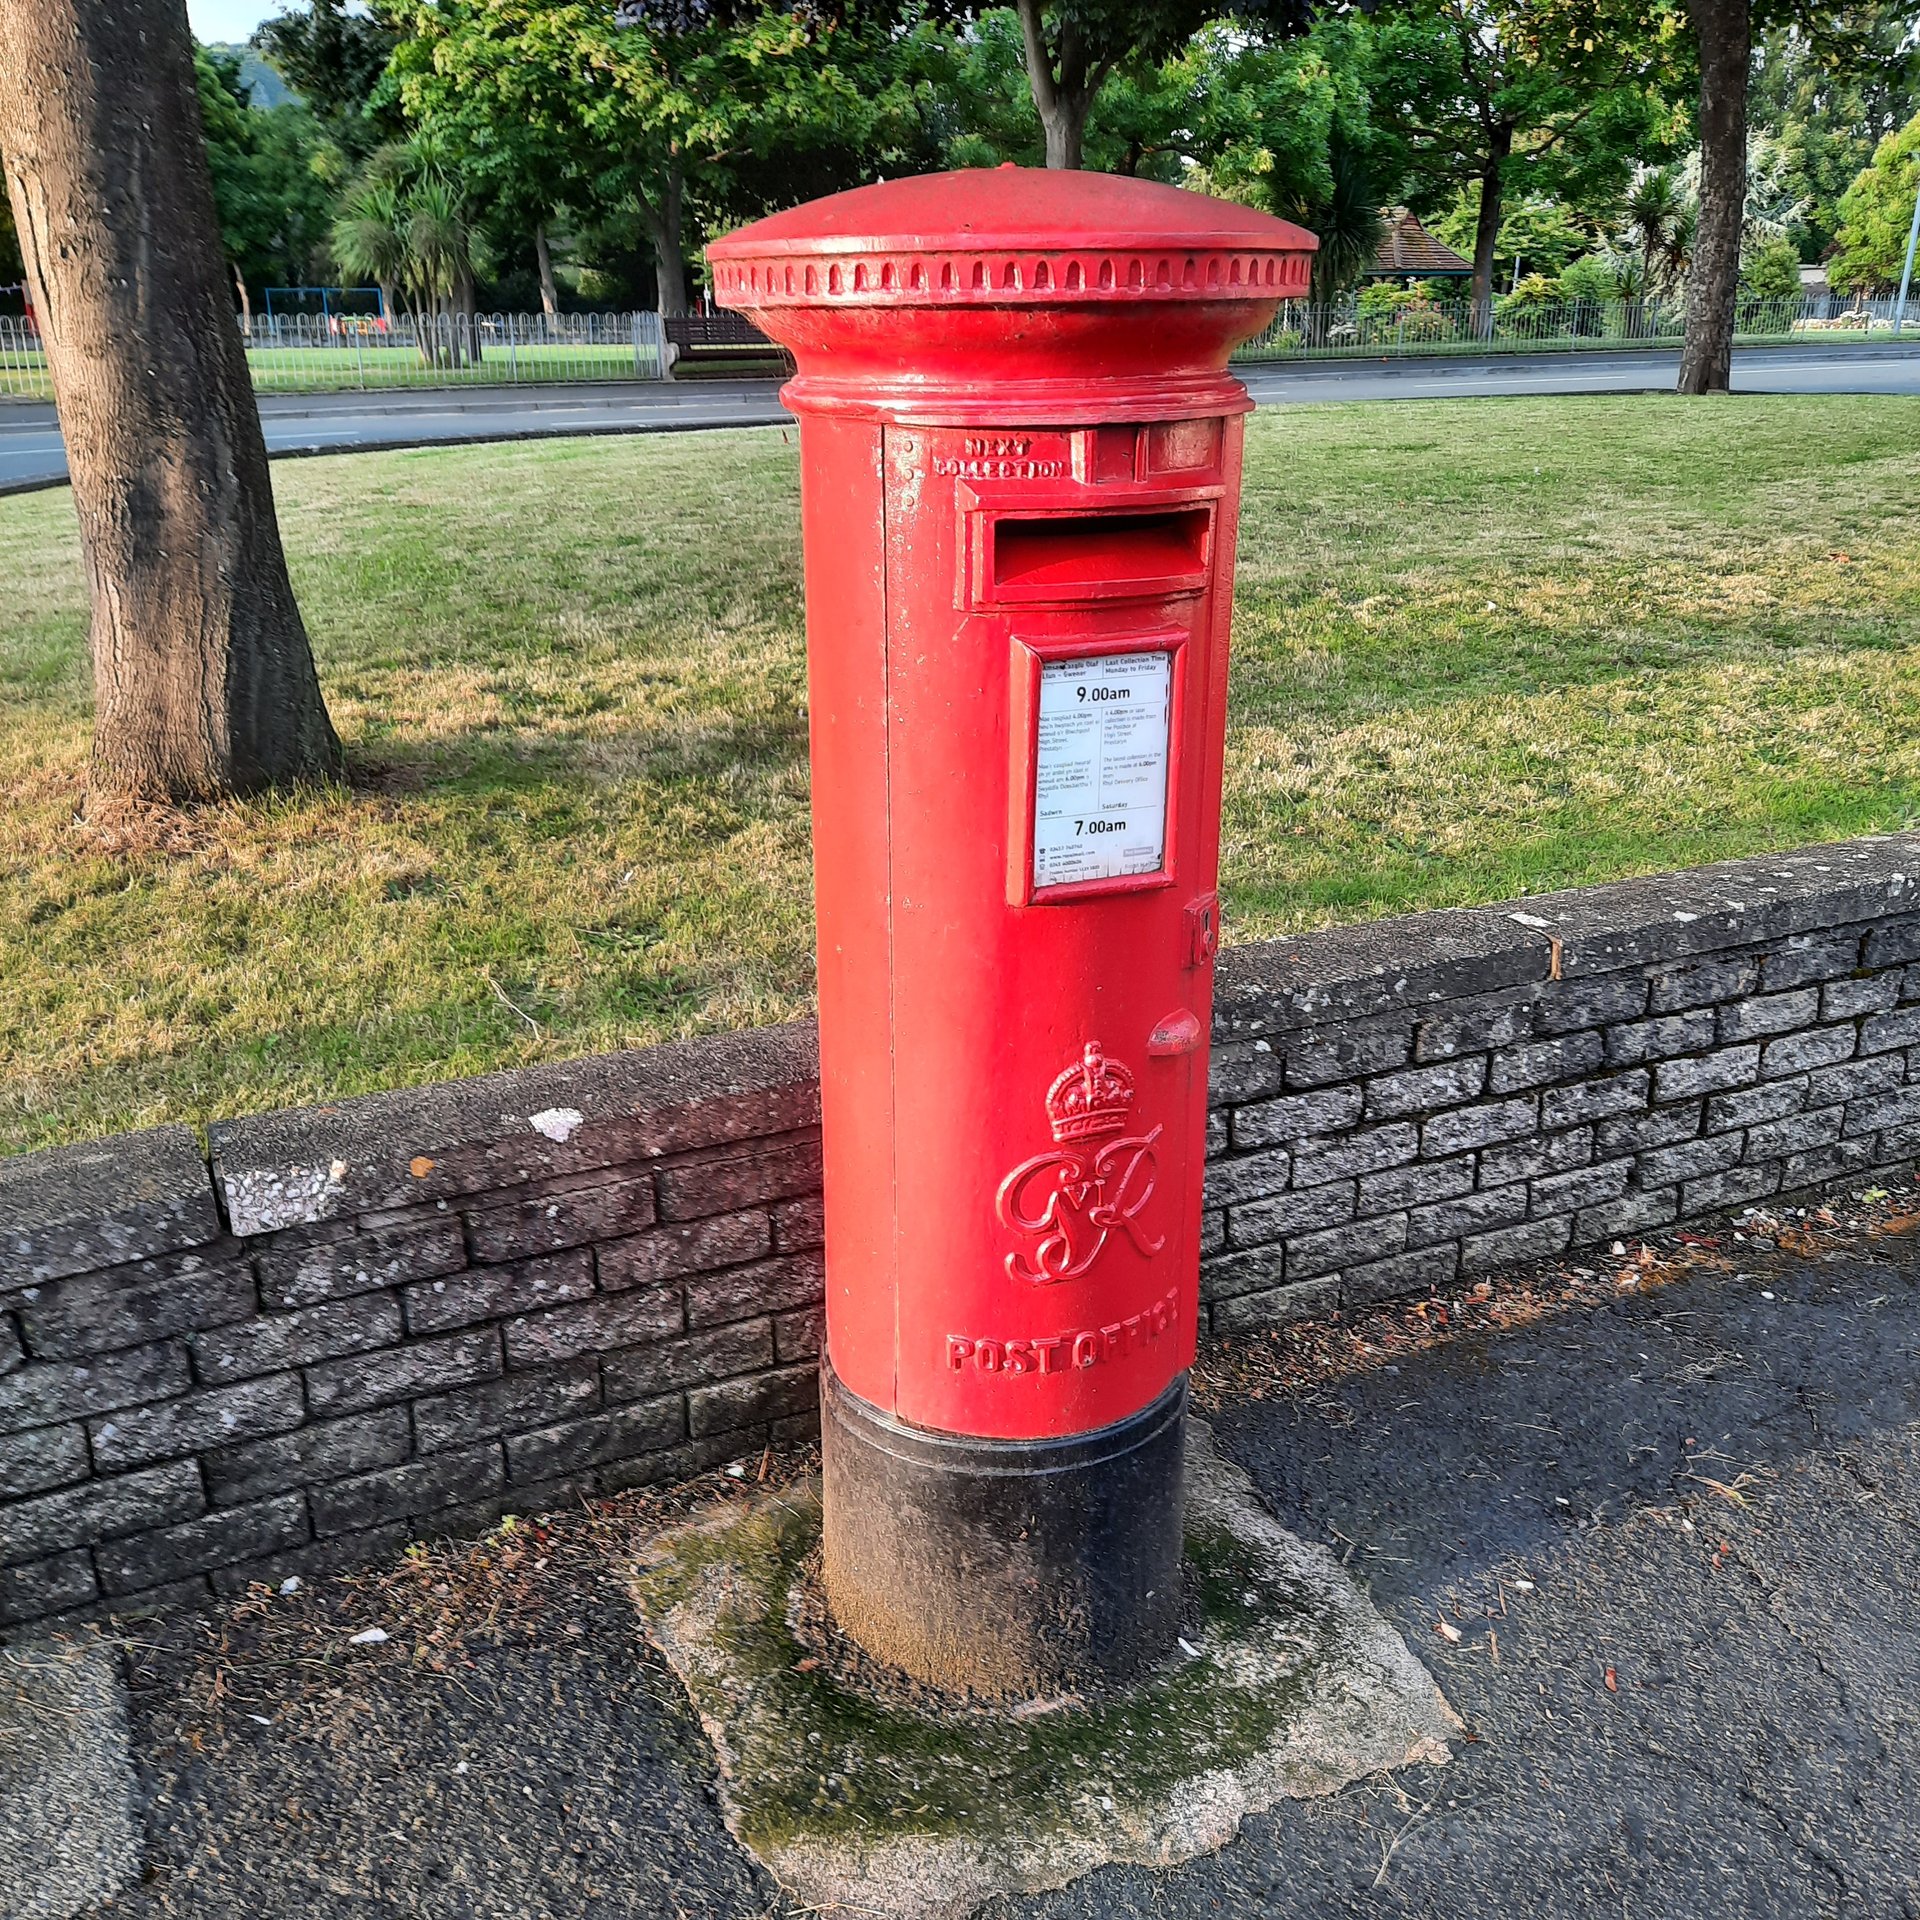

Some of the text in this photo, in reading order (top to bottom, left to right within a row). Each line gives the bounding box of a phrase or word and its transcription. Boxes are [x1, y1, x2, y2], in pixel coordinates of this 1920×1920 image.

[965, 437, 1032, 457] NEXT
[933, 457, 1066, 479] COLLECTION
[1120, 656, 1149, 664] Collection
[1076, 686, 1131, 703] 9.00am
[1102, 802, 1128, 810] Saturday
[1074, 820, 1126, 836] 7.00am
[946, 1334, 1062, 1373] POST
